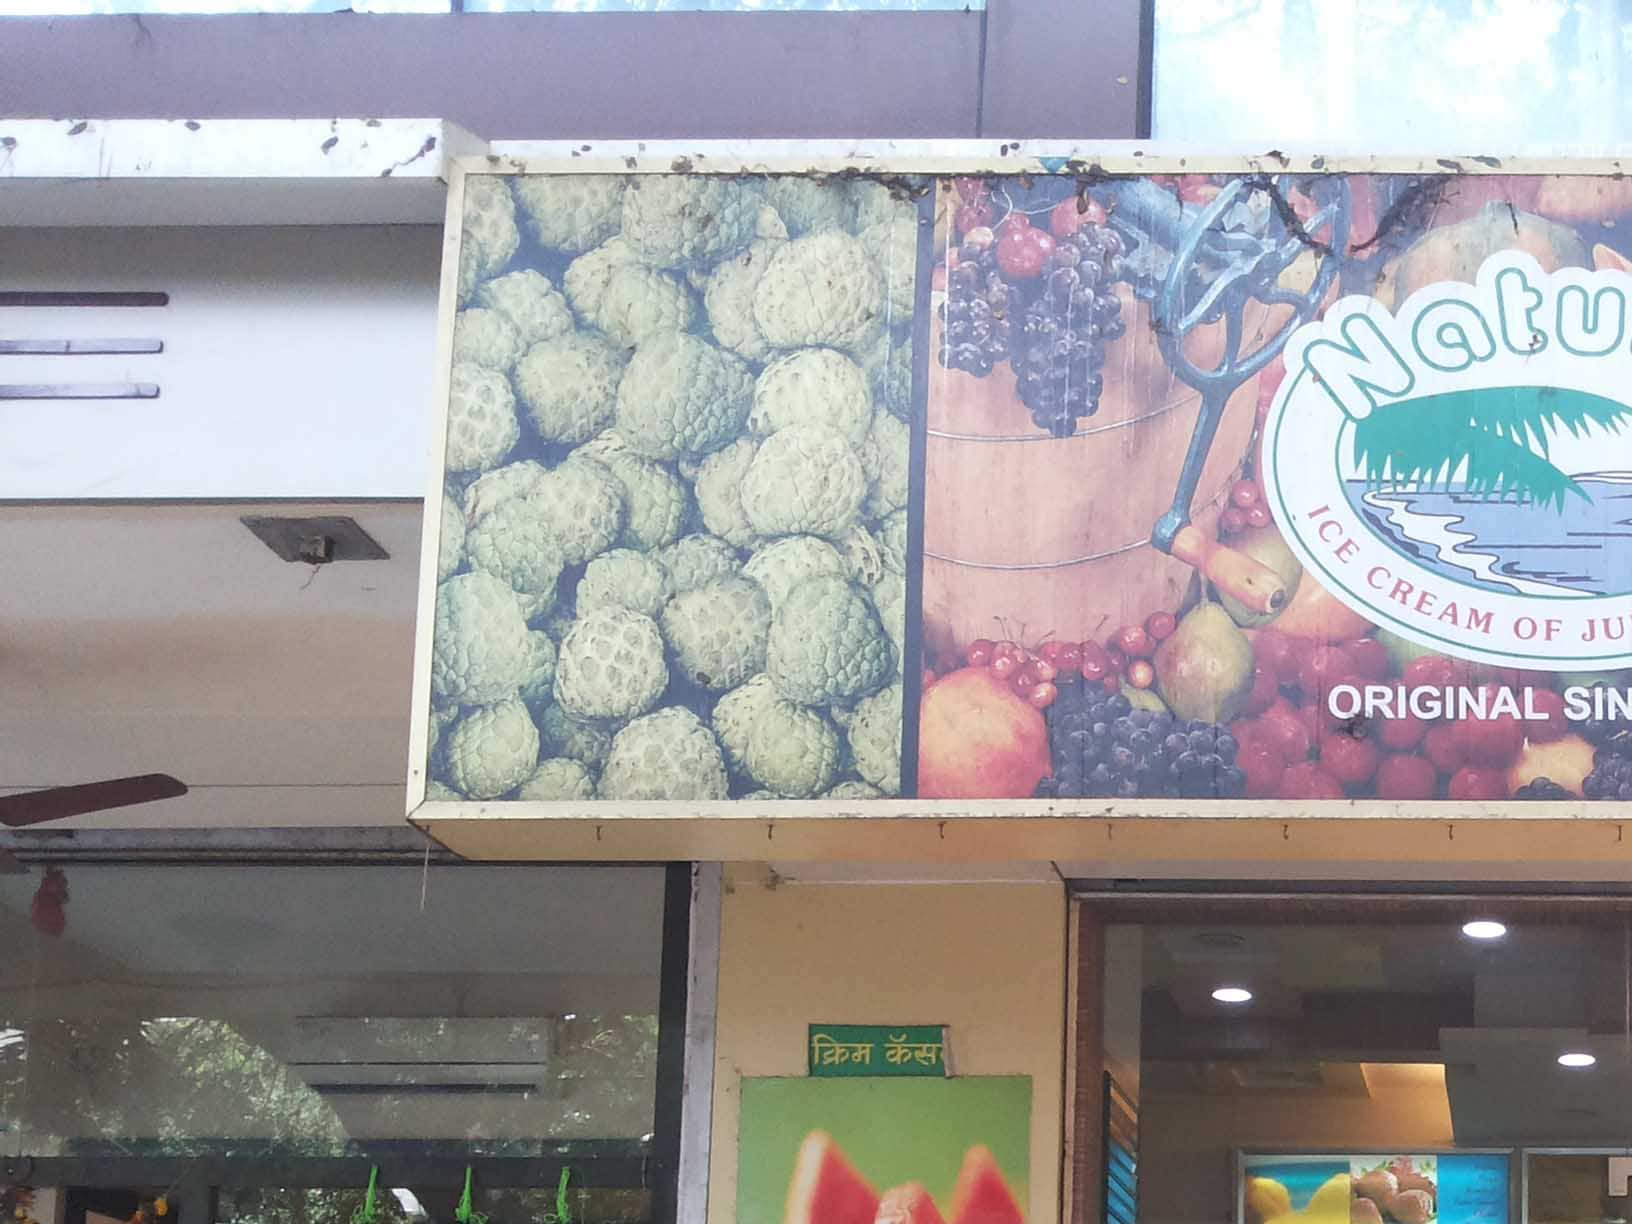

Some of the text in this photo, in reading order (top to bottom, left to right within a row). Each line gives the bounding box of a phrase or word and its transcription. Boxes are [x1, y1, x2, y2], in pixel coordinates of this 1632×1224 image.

[1307, 502, 1362, 565] ICE
[1366, 565, 1494, 634] CREAM
[1513, 618, 1563, 641] OF
[1327, 684, 1550, 721] ORIGINAL
